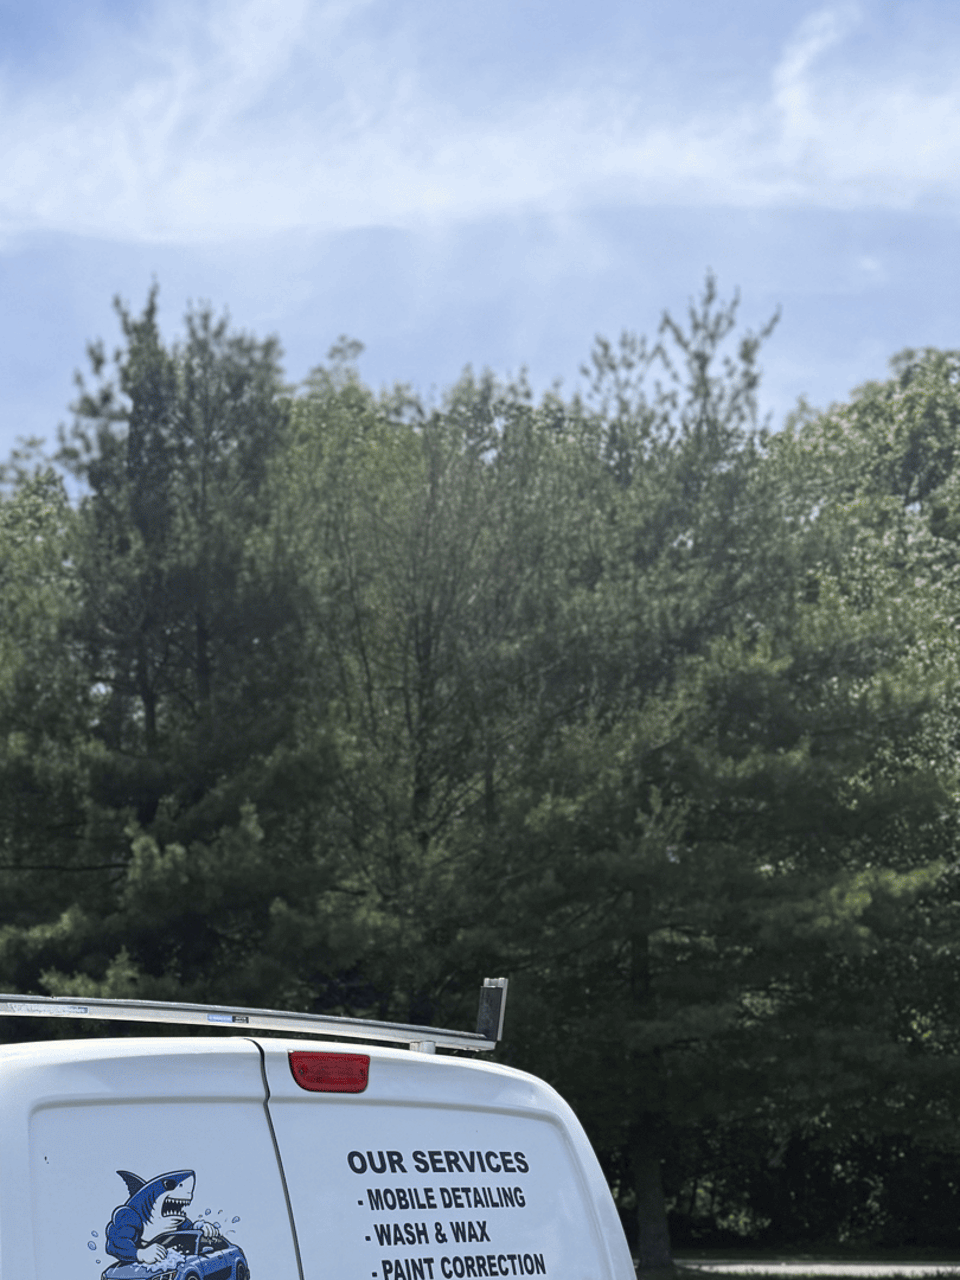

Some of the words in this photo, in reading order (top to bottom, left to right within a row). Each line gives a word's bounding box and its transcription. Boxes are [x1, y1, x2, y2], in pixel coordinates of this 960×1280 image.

[347, 1150, 408, 1174] OUR
[412, 1150, 530, 1174] SERVICES
[366, 1187, 437, 1210] MOBILE
[439, 1186, 526, 1208] DETAILING
[373, 1222, 429, 1246] WASH
[434, 1221, 448, 1244] &
[449, 1220, 491, 1243] WAX
[440, 1253, 546, 1279] CORRECTION
